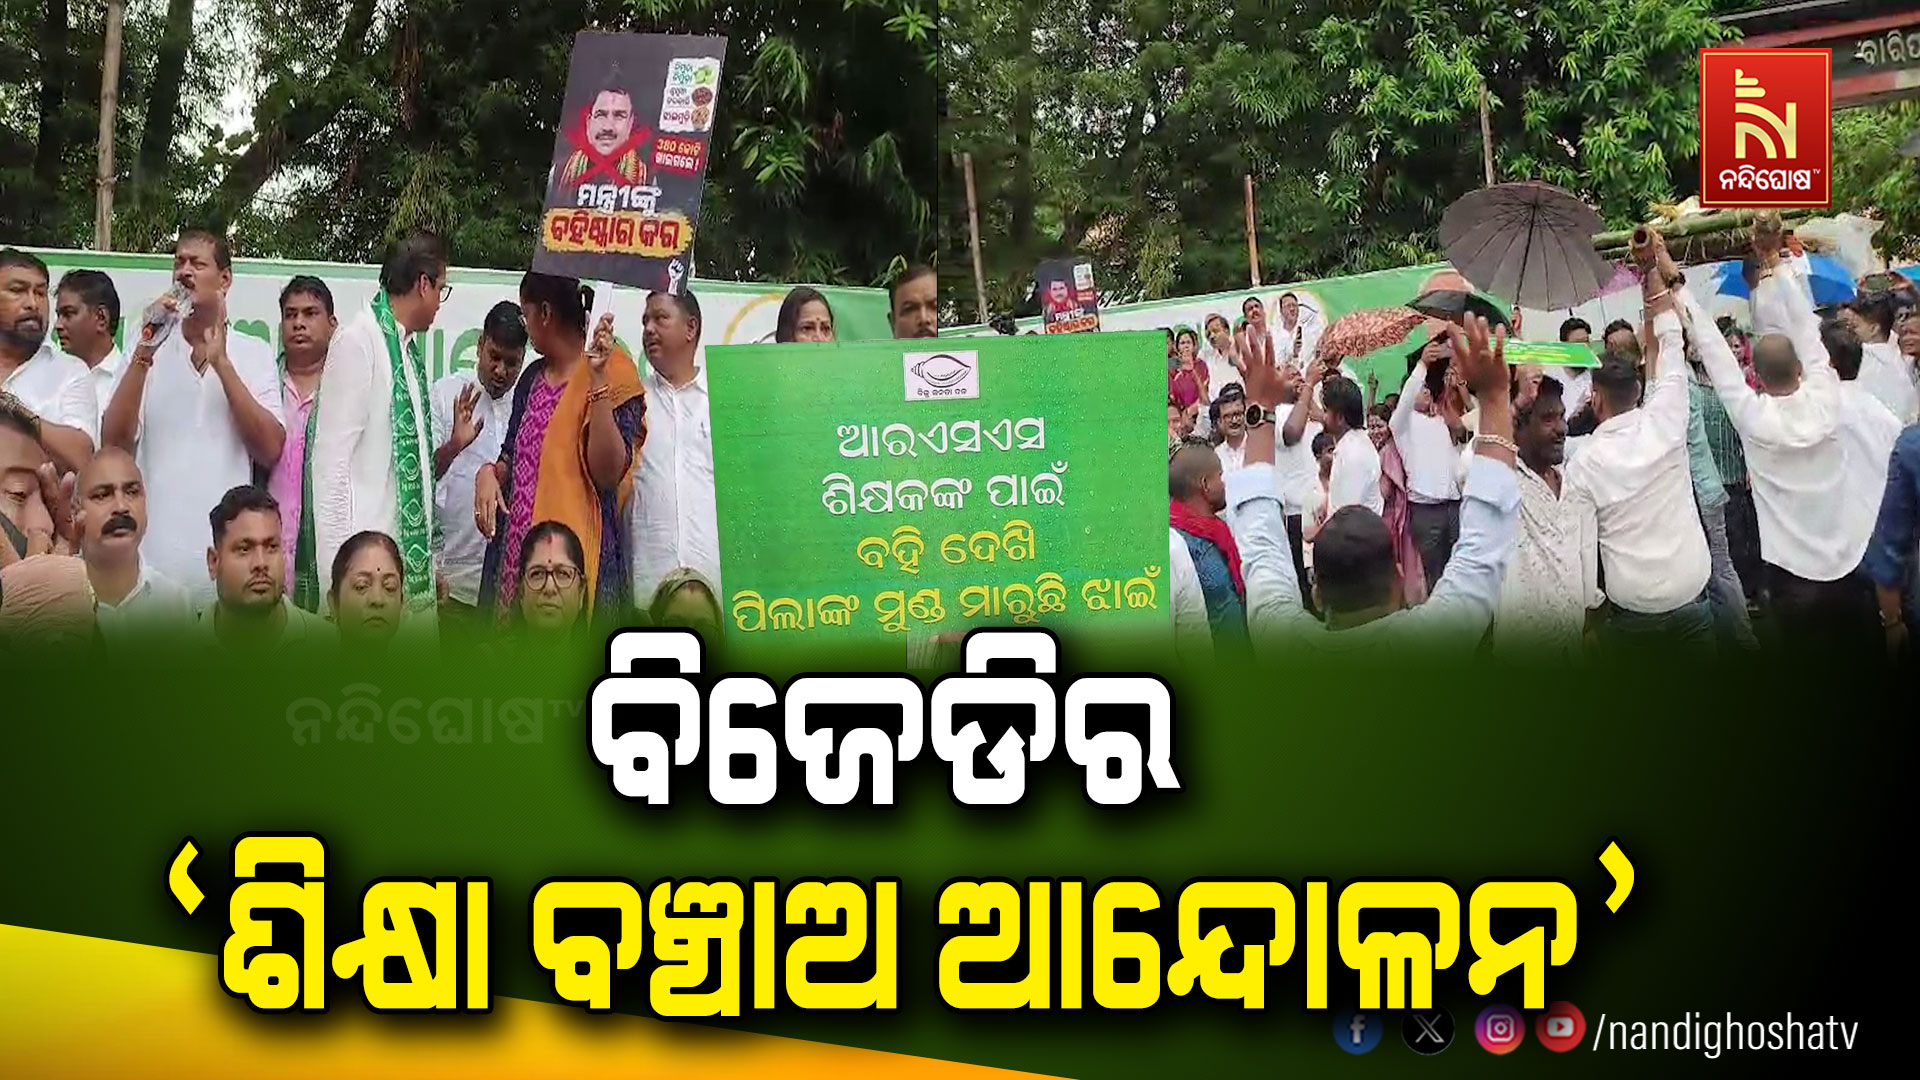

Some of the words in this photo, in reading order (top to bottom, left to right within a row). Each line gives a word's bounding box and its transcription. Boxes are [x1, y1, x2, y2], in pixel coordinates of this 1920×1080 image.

[657, 138, 677, 152] 380
[639, 218, 680, 250] କର
[836, 416, 1046, 458] ଆରଏସଏସ
[821, 472, 973, 516] ଶିକ୍ଷକଙ୍କ
[986, 460, 1069, 508] ପାଇଁ
[856, 525, 926, 575] ବହି
[940, 519, 1036, 564] ଦେଖି
[732, 589, 860, 632] ପିଲାଙ୍କ
[873, 588, 947, 633] ମୁଣ୍ଡ
[959, 571, 1068, 624] ମାରୁଛି
[1081, 565, 1161, 612] ଝାଇଁ
